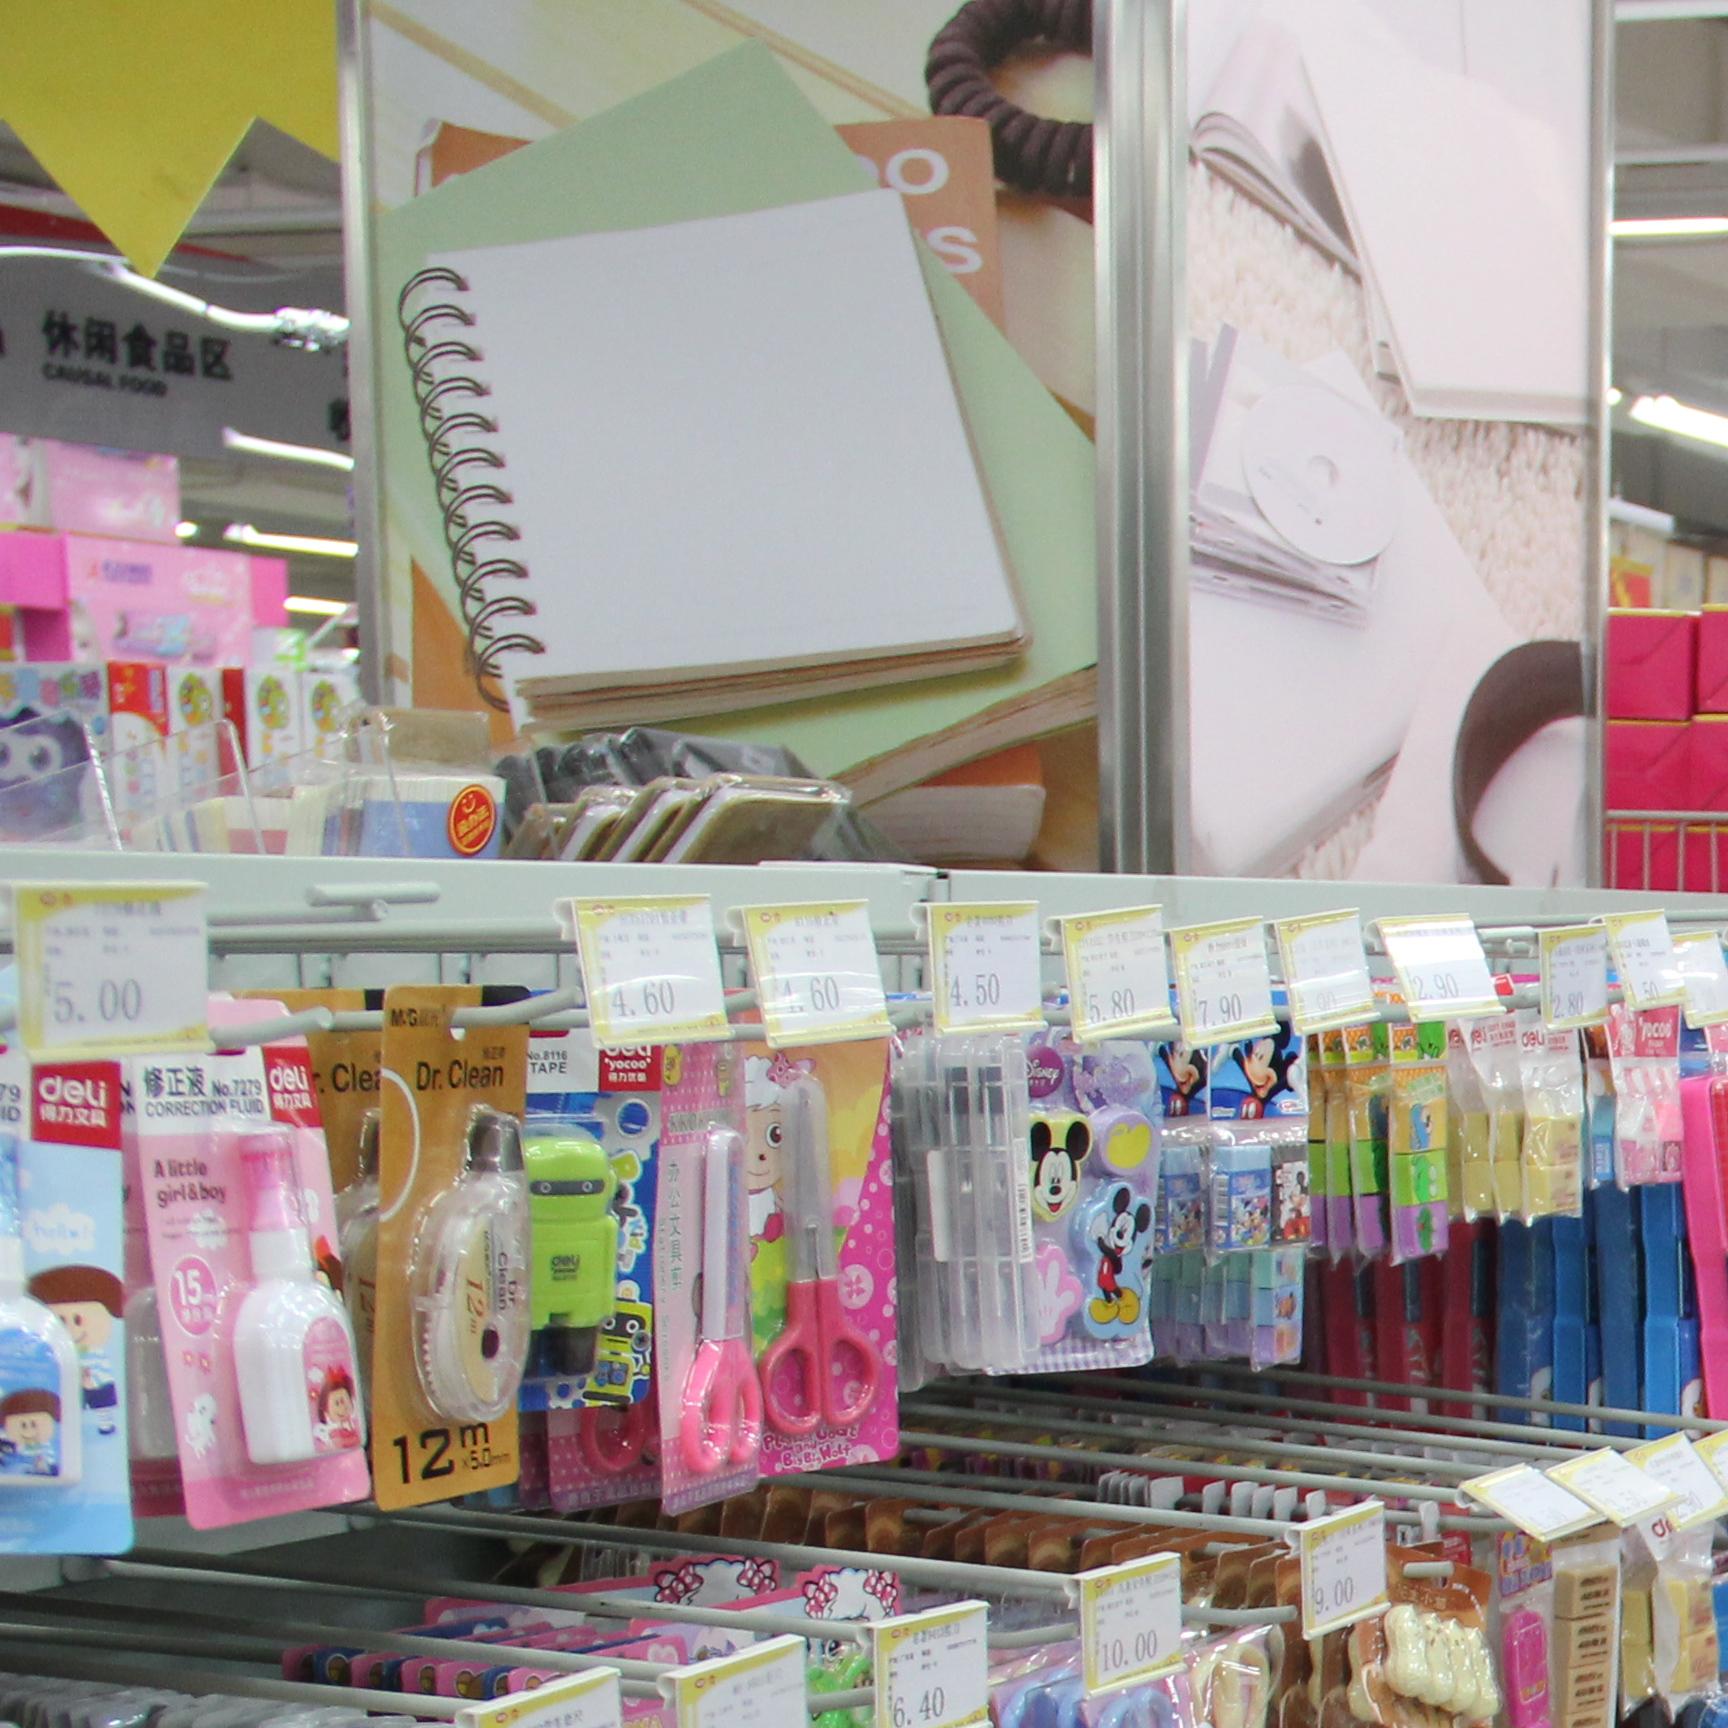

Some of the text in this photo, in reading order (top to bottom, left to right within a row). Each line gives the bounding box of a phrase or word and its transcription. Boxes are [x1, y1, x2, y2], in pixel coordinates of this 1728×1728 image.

[42, 309, 234, 381] 休闲食品区
[53, 978, 143, 1024] 5.00
[611, 980, 676, 1018] 4.60
[784, 975, 840, 1014] 4.60
[950, 973, 1000, 1008] 4.50
[1413, 973, 1459, 1000] 2.90
[1088, 988, 1135, 1022] 5.80
[1199, 993, 1242, 1030] 7.90
[1552, 991, 1585, 1020] 2.80
[1521, 1031, 1546, 1047] deli
[144, 1066, 262, 1098] 修正液 No.7279
[269, 1062, 310, 1091] deli
[332, 1062, 382, 1093] Clea
[416, 1058, 504, 1091] Dr. Clean
[529, 1062, 567, 1075] TAPE
[39, 1076, 108, 1109] deli
[145, 1097, 264, 1118] CORRECTION FLUID
[272, 1089, 312, 1110] 得力文具
[40, 1106, 107, 1128] 得力文具
[167, 1159, 208, 1178] little
[157, 1181, 227, 1208] girl&boy
[174, 1269, 202, 1306] 15
[1314, 1576, 1355, 1616] 9.00
[1102, 1629, 1158, 1672] 10.00
[893, 1686, 945, 1728] 6.40
